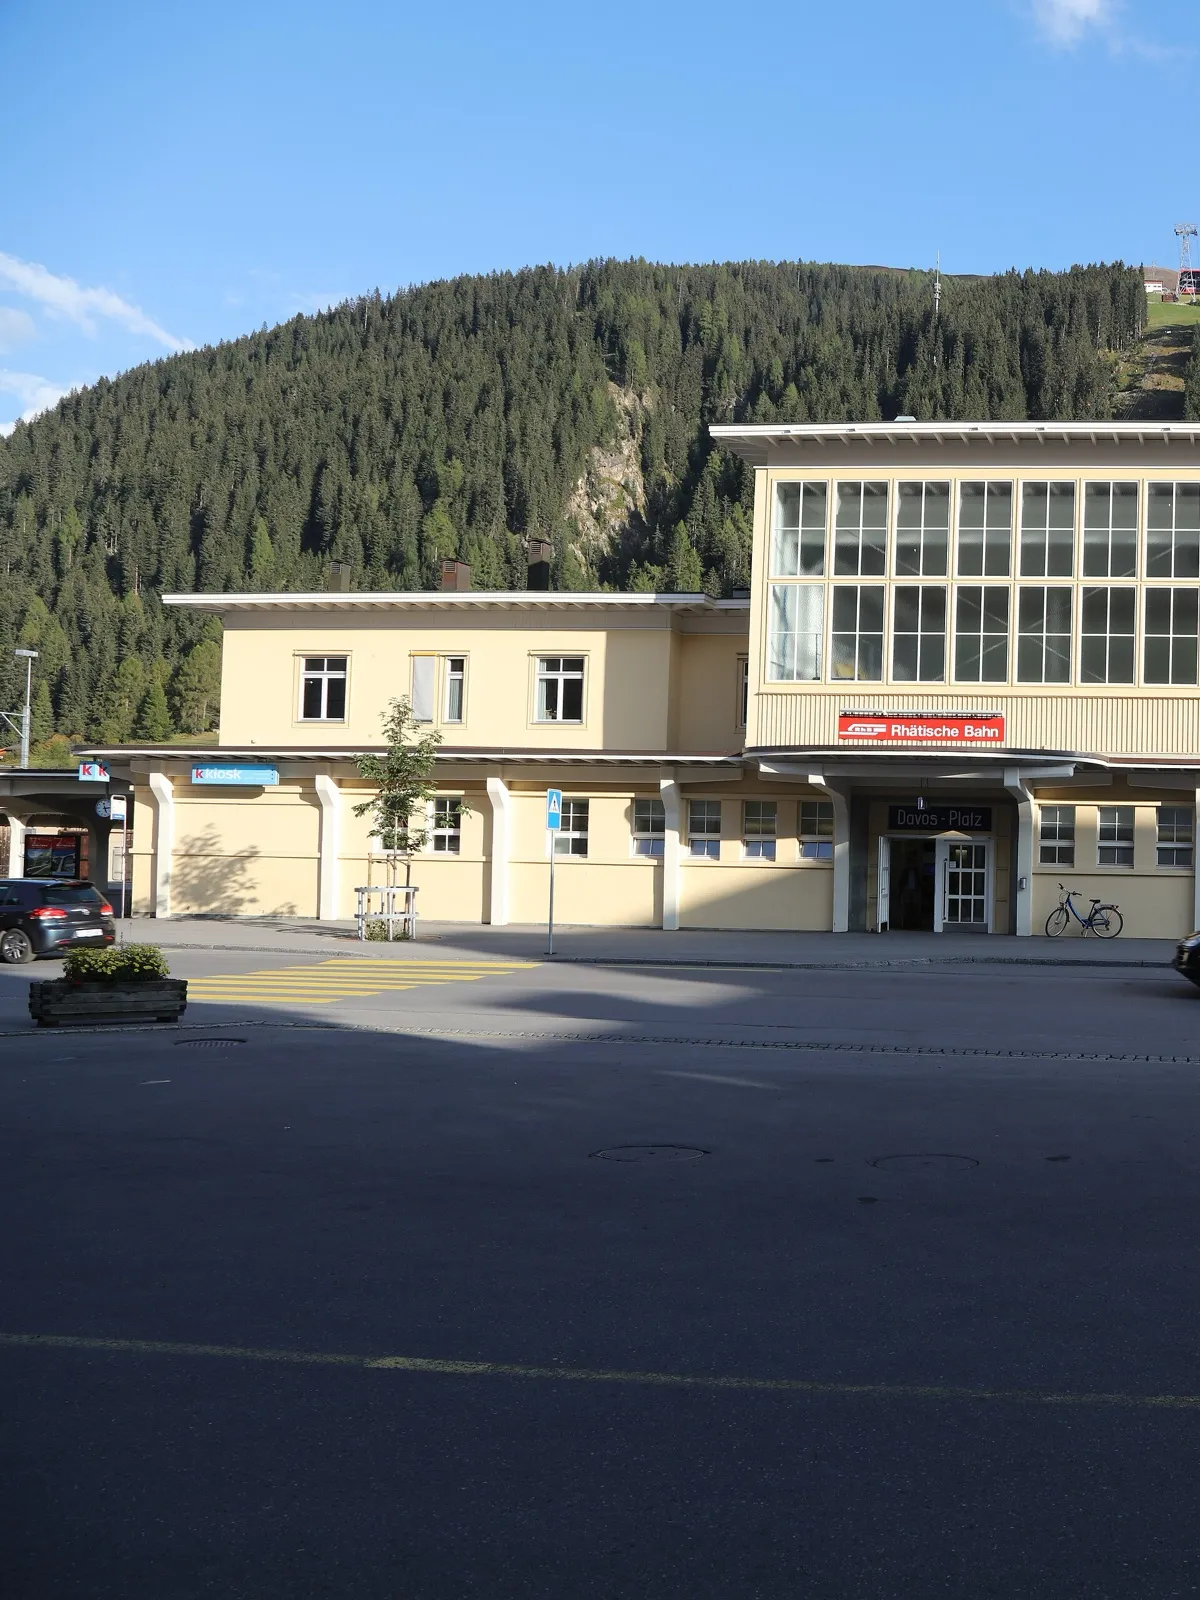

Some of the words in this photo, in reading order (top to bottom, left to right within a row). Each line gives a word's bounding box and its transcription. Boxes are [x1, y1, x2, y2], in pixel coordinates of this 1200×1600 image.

[891, 724, 960, 737] Rhätische
[964, 725, 999, 738] Bahn
[205, 768, 241, 780] kiosk
[897, 809, 938, 826] Davos
[949, 810, 982, 827] Platz
